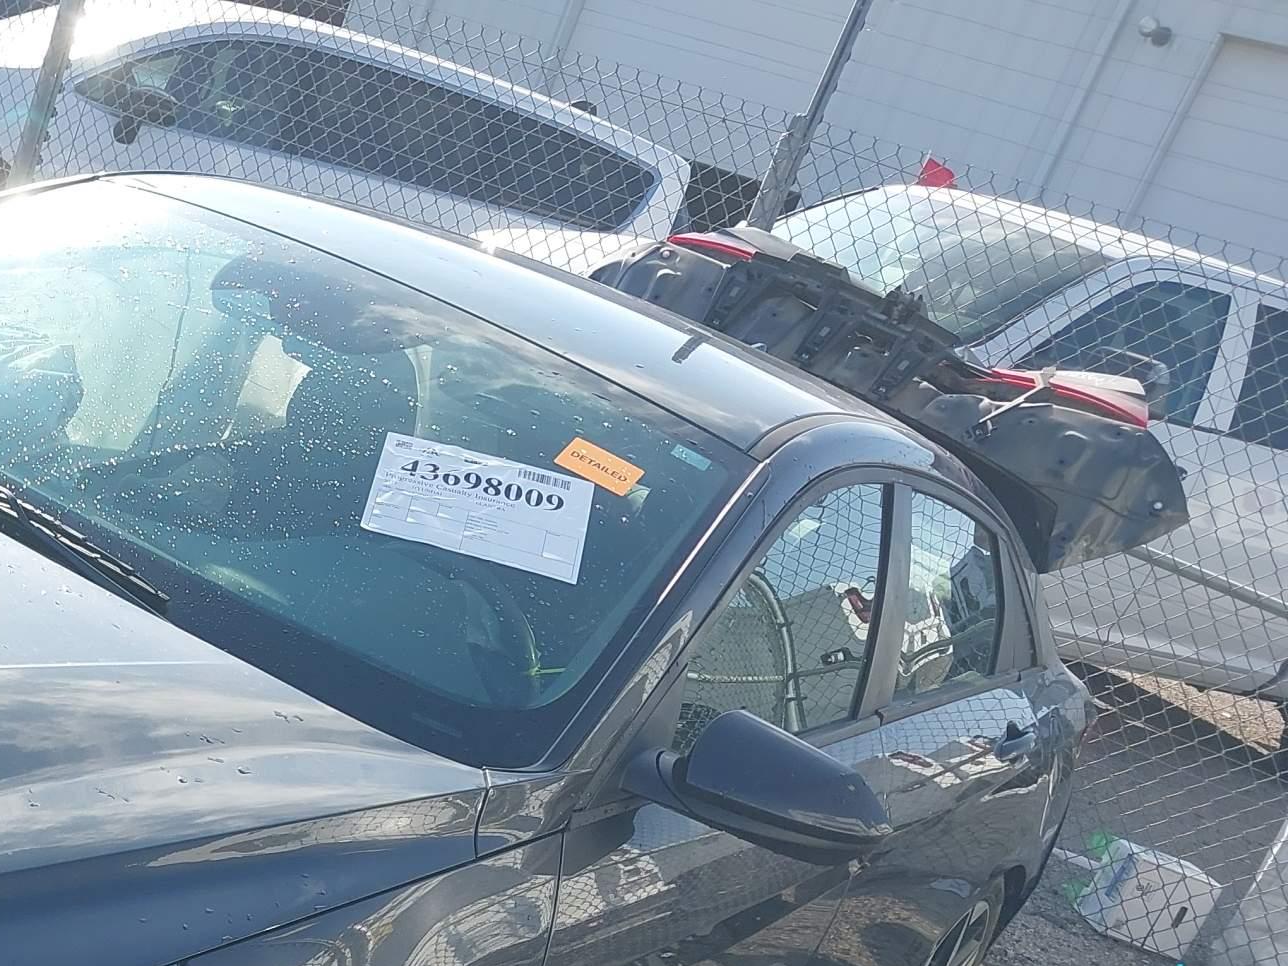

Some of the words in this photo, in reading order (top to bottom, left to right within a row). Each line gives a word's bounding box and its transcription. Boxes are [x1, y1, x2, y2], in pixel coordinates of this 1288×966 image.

[570, 450, 628, 482] DETAILED
[400, 459, 565, 511] 43698009
[436, 484, 472, 497] Casualty
[474, 493, 516, 509] Insurance
